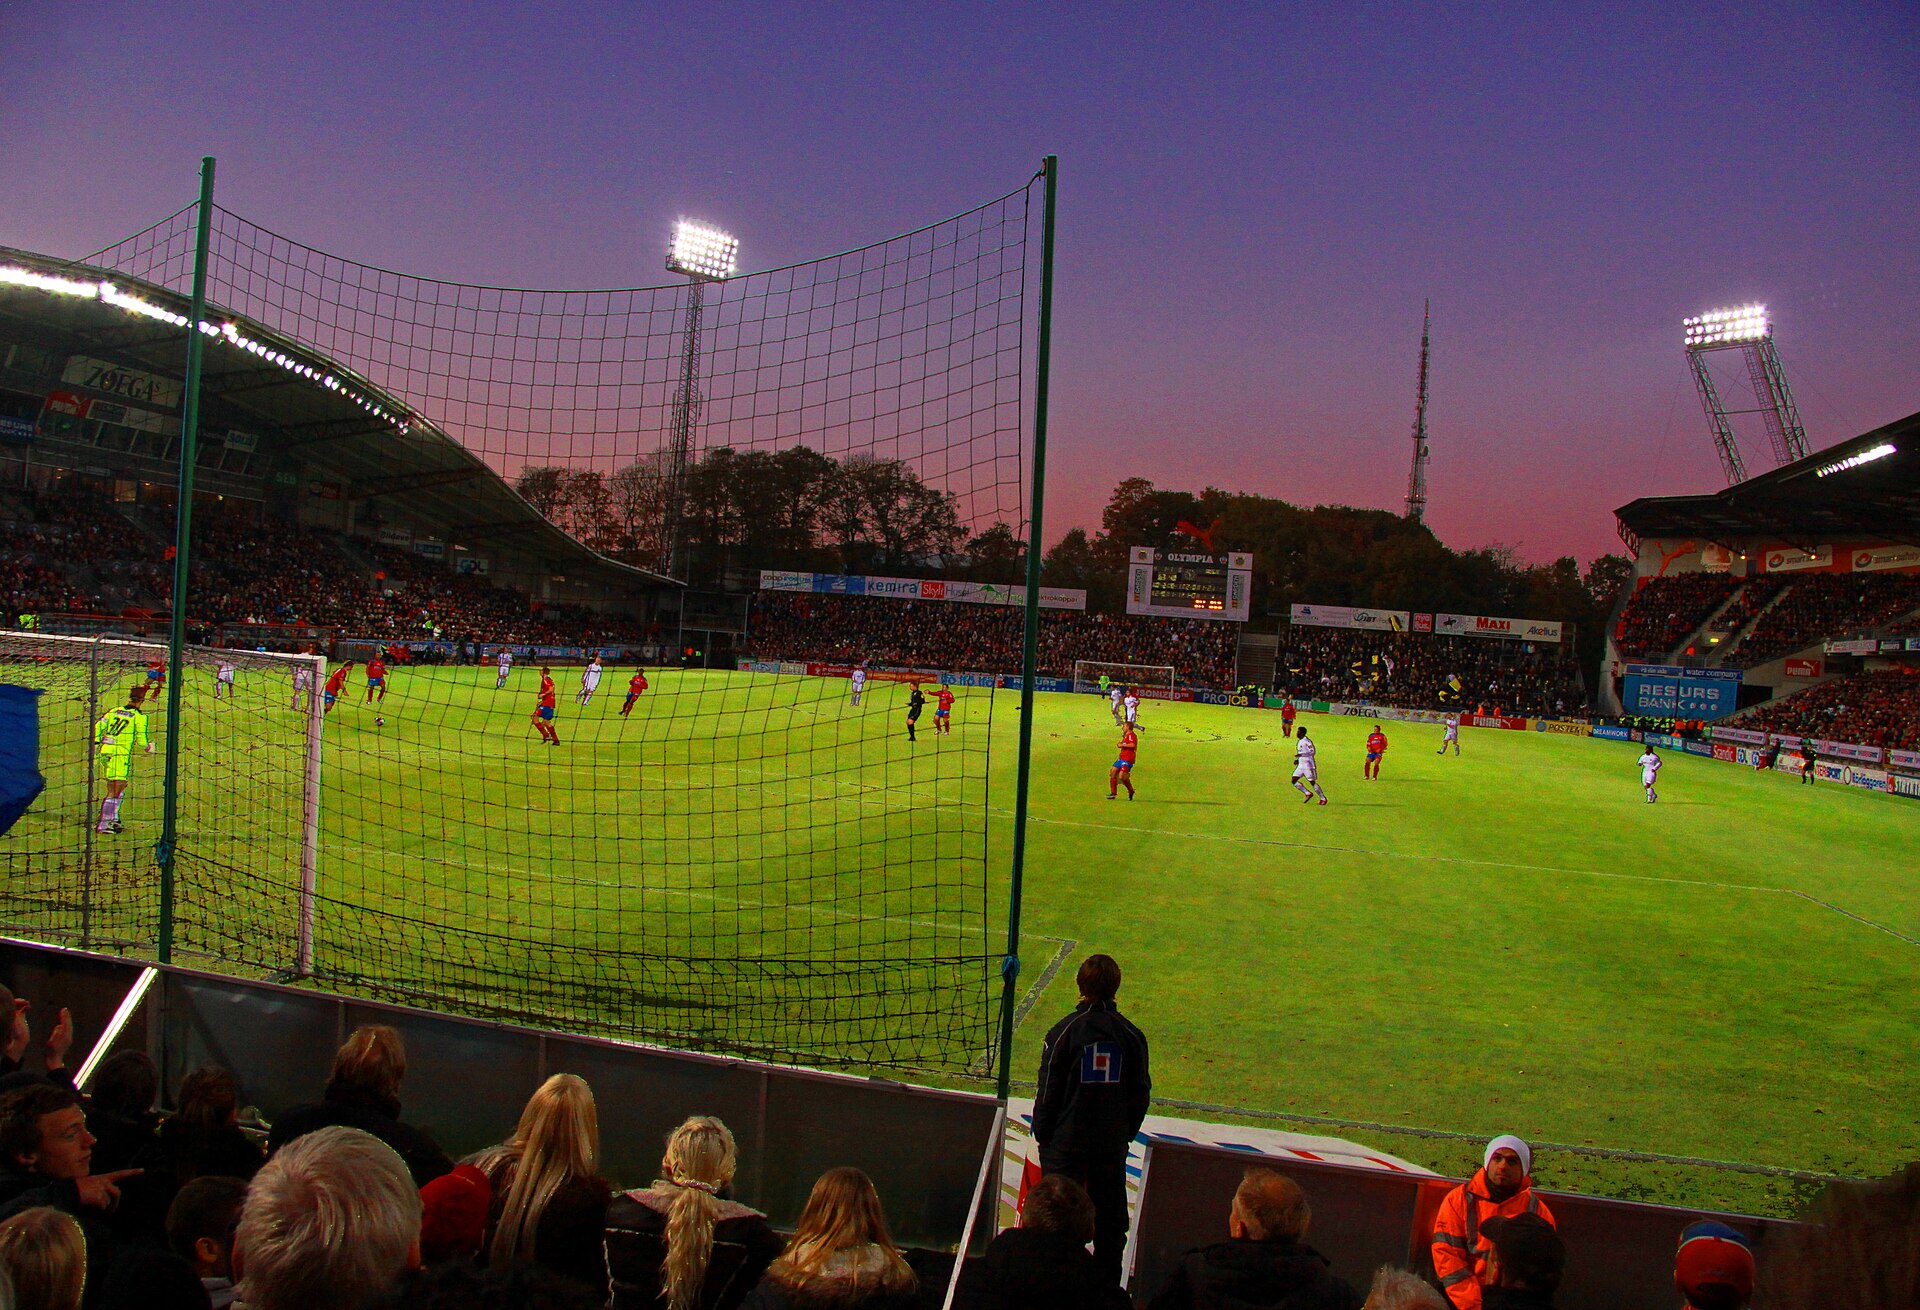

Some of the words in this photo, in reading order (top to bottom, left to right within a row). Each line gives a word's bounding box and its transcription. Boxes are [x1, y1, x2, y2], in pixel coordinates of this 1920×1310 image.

[1168, 553, 1214, 564] OLYMPIA
[868, 580, 918, 594] kemira
[1477, 617, 1511, 630] MAXI
[1527, 626, 1558, 637] Akelius
[1706, 670, 1738, 680] company
[1787, 667, 1811, 676] PUMA
[1639, 683, 1720, 700] RESURS
[1639, 697, 1686, 711] BANK
[1473, 716, 1502, 728] PUMA
